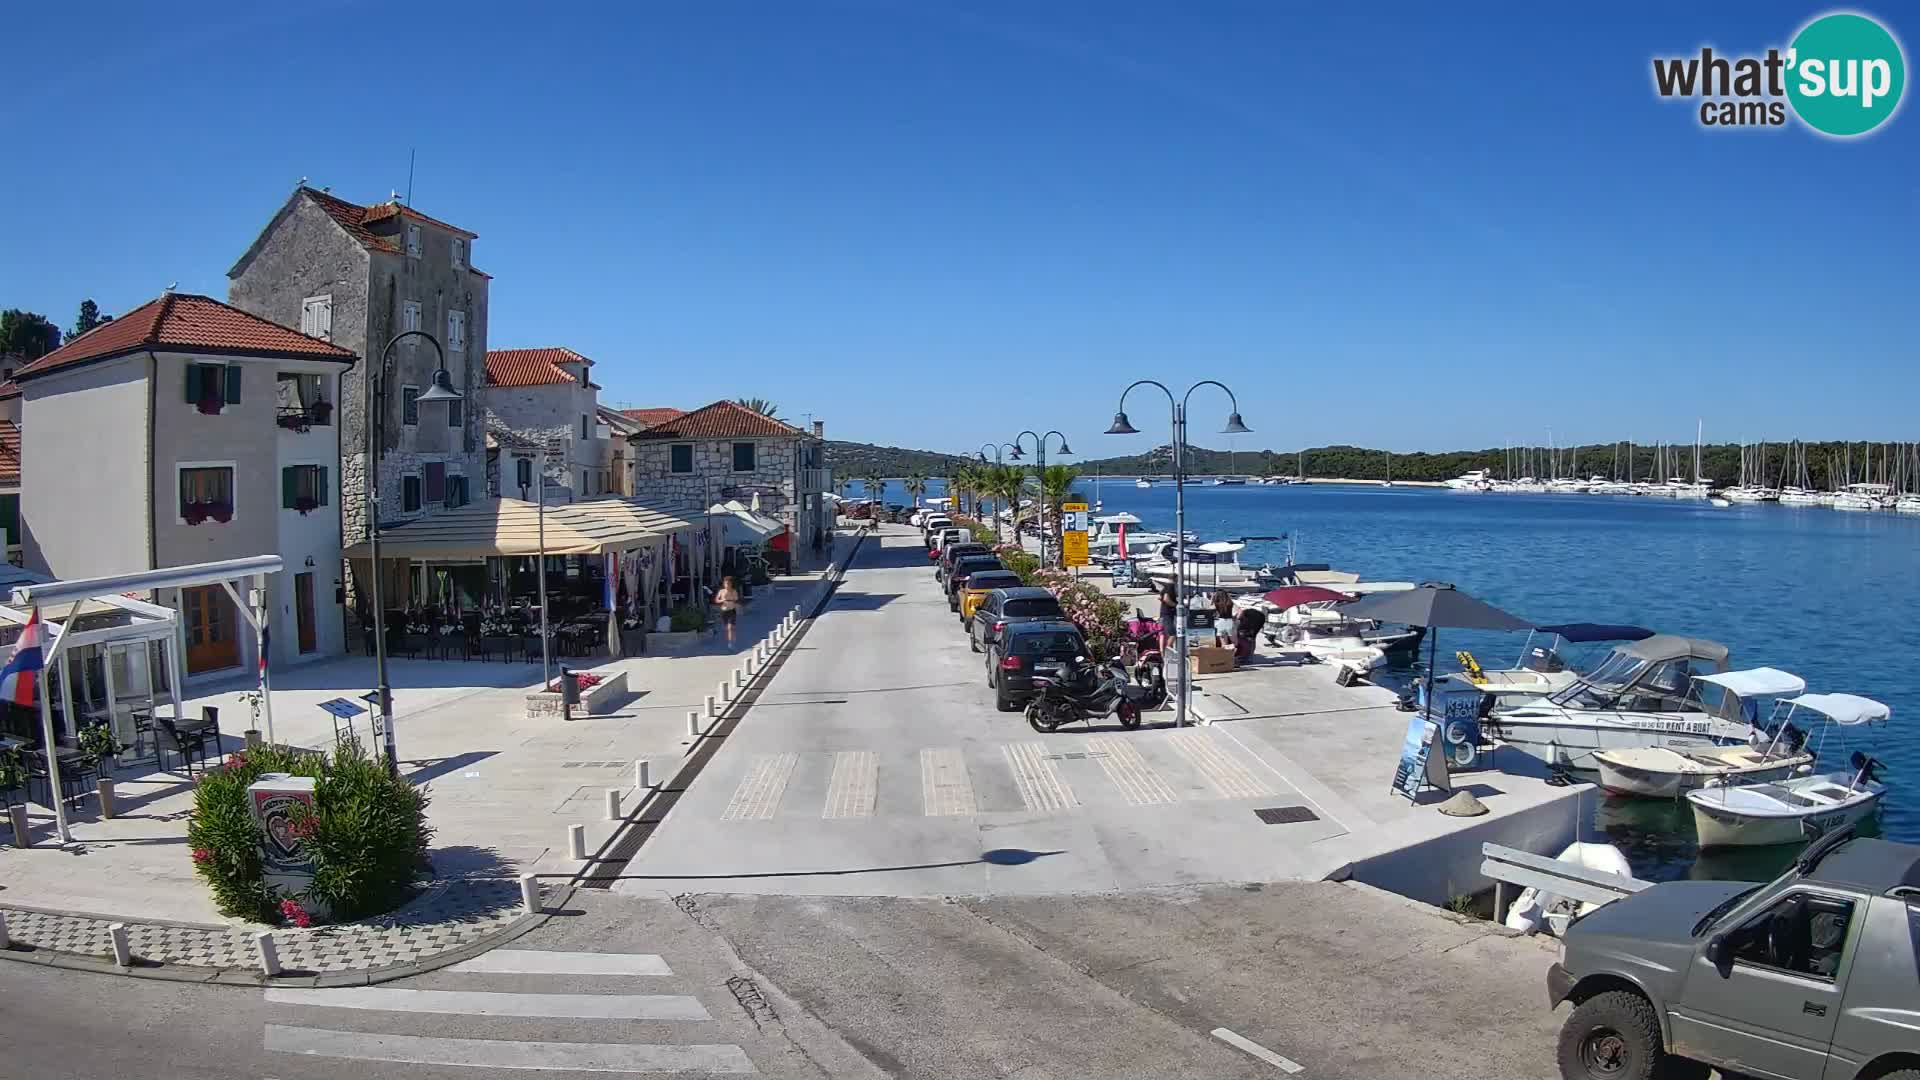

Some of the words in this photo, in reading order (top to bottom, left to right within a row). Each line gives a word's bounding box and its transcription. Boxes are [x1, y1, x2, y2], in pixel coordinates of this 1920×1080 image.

[1064, 513, 1075, 529] P
[1447, 696, 1478, 709] RENT
[1447, 709, 1453, 717] A
[1666, 722, 1685, 732] RENT
[1686, 722, 1692, 731] A
